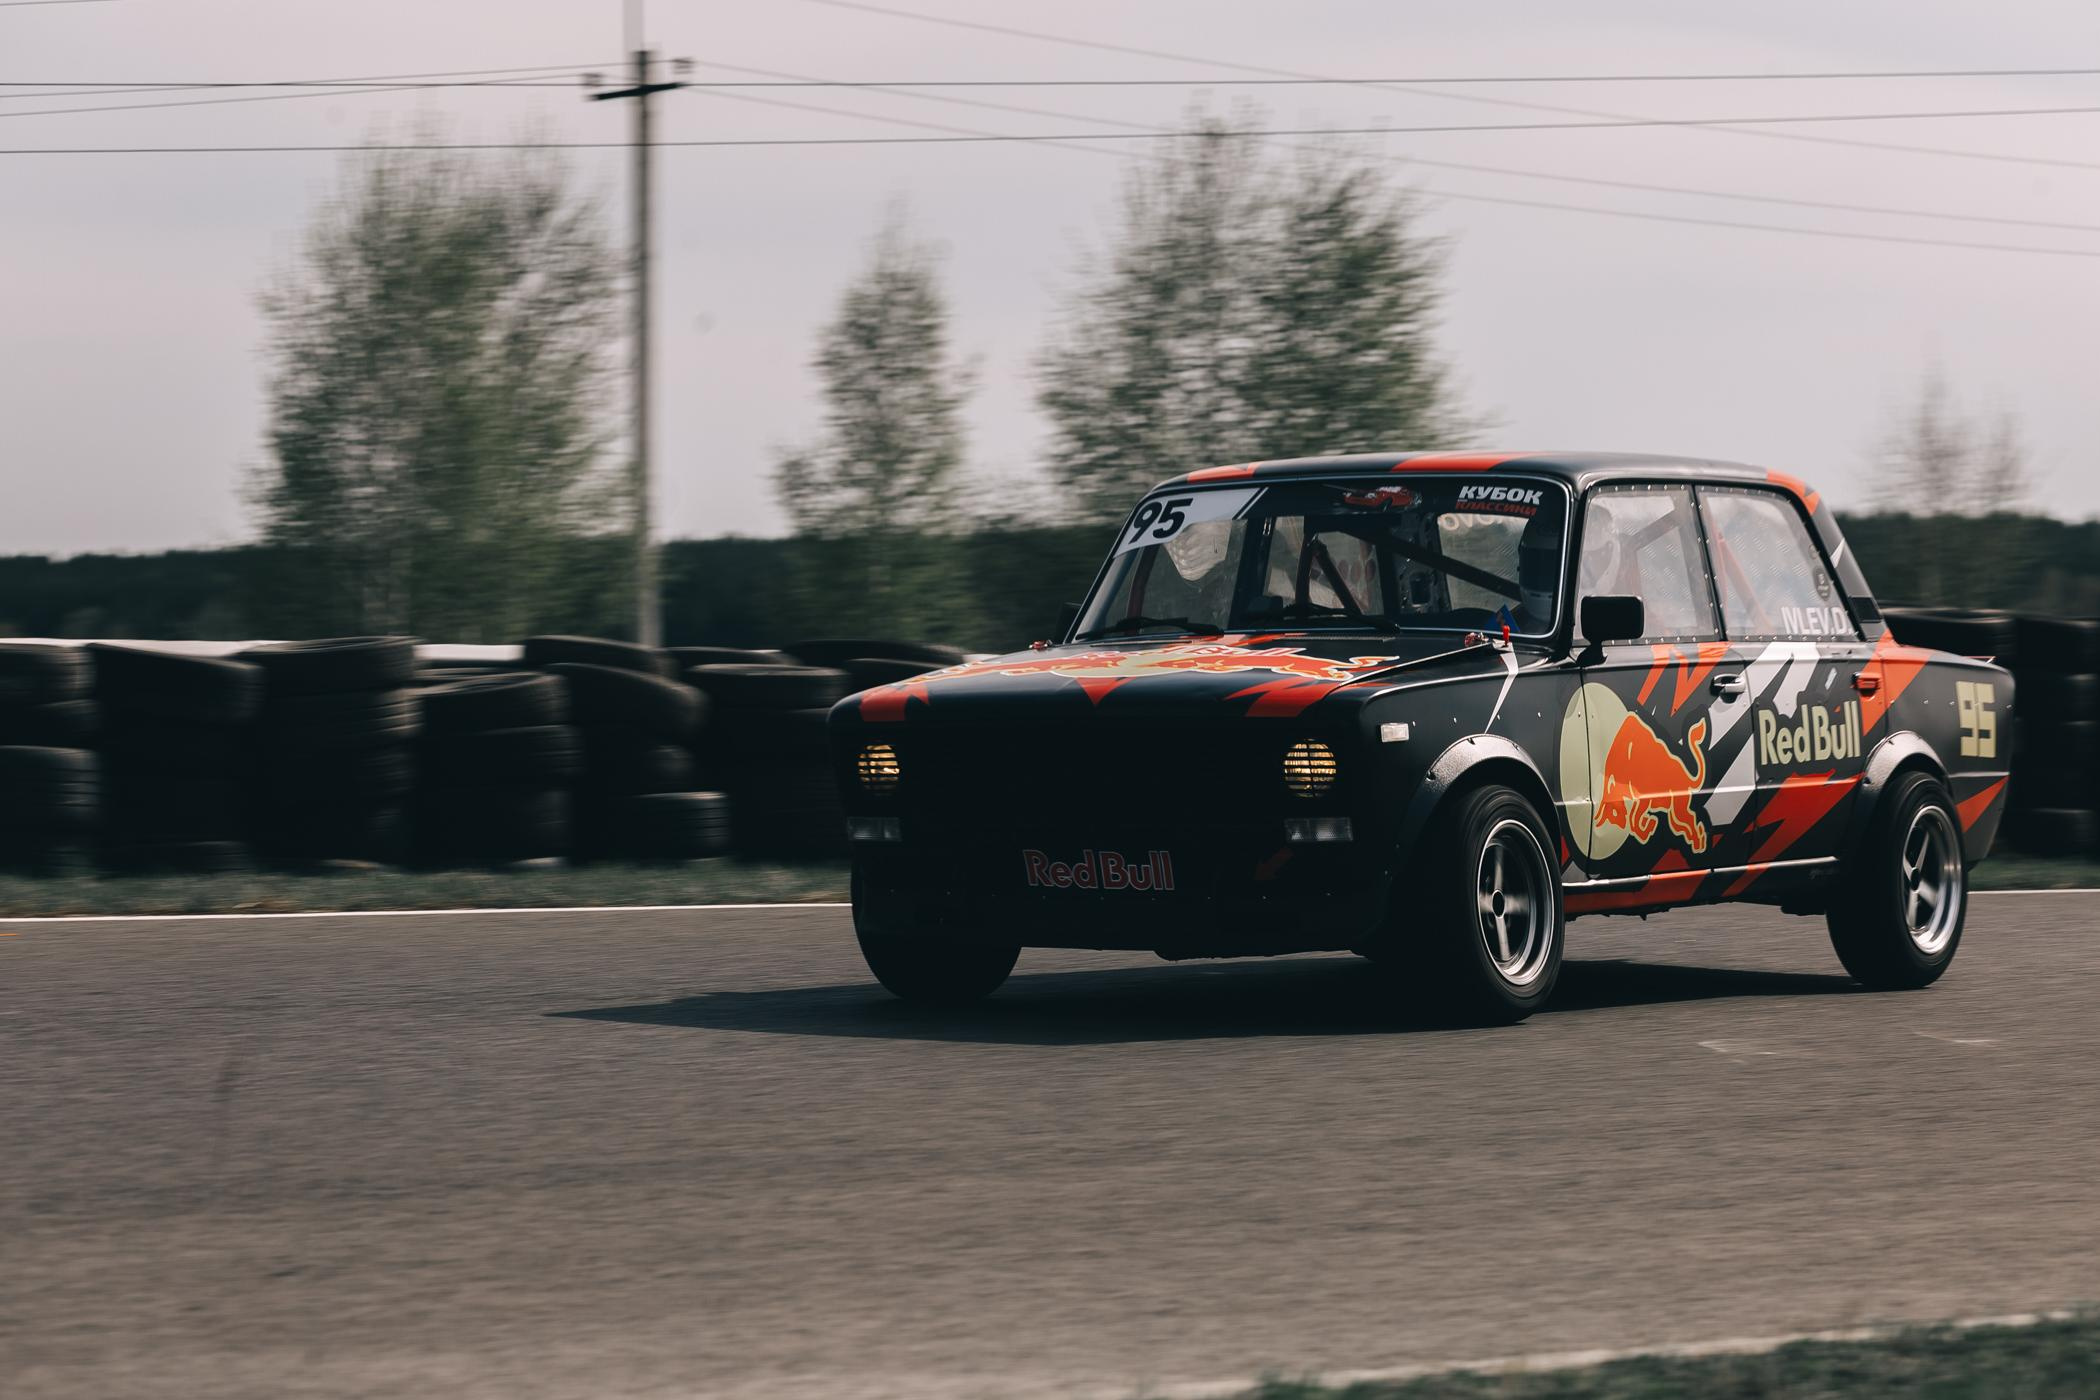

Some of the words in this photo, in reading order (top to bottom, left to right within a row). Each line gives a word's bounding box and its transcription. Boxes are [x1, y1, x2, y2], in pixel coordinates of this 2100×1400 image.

[1458, 486, 1543, 505] КУБОК
[1128, 497, 1194, 544] 95
[1758, 704, 1811, 765] Red
[1811, 700, 1861, 761] Bull
[1955, 680, 1996, 758] 95
[1022, 848, 1099, 888] Red
[1098, 850, 1175, 891] Bull
